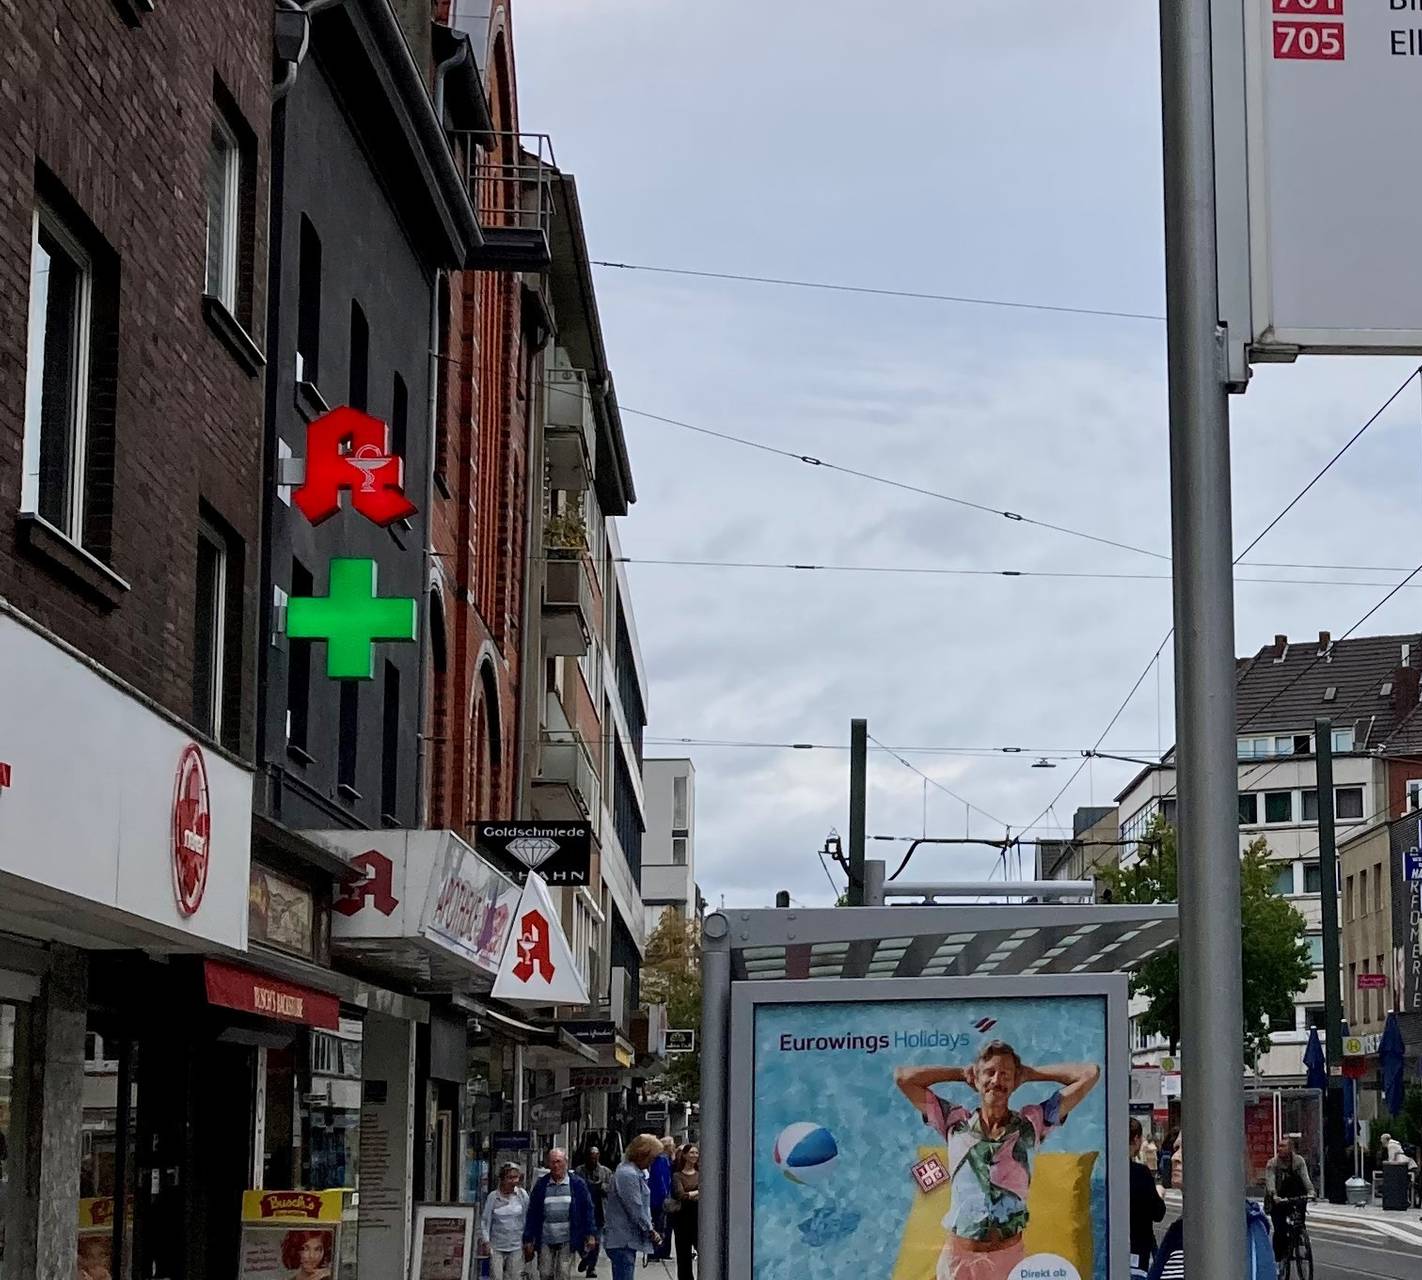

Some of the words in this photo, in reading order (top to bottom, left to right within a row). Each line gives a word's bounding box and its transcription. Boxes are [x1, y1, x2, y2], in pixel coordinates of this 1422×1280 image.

[1276, 27, 1341, 55] 705
[483, 826, 586, 838] Goldschmiede
[780, 1031, 890, 1053] Eurowings
[894, 1030, 970, 1050] Holidays
[267, 1195, 315, 1210] Busch's
[1020, 1269, 1050, 1279] Direkt
[1053, 1268, 1067, 1278] ab
